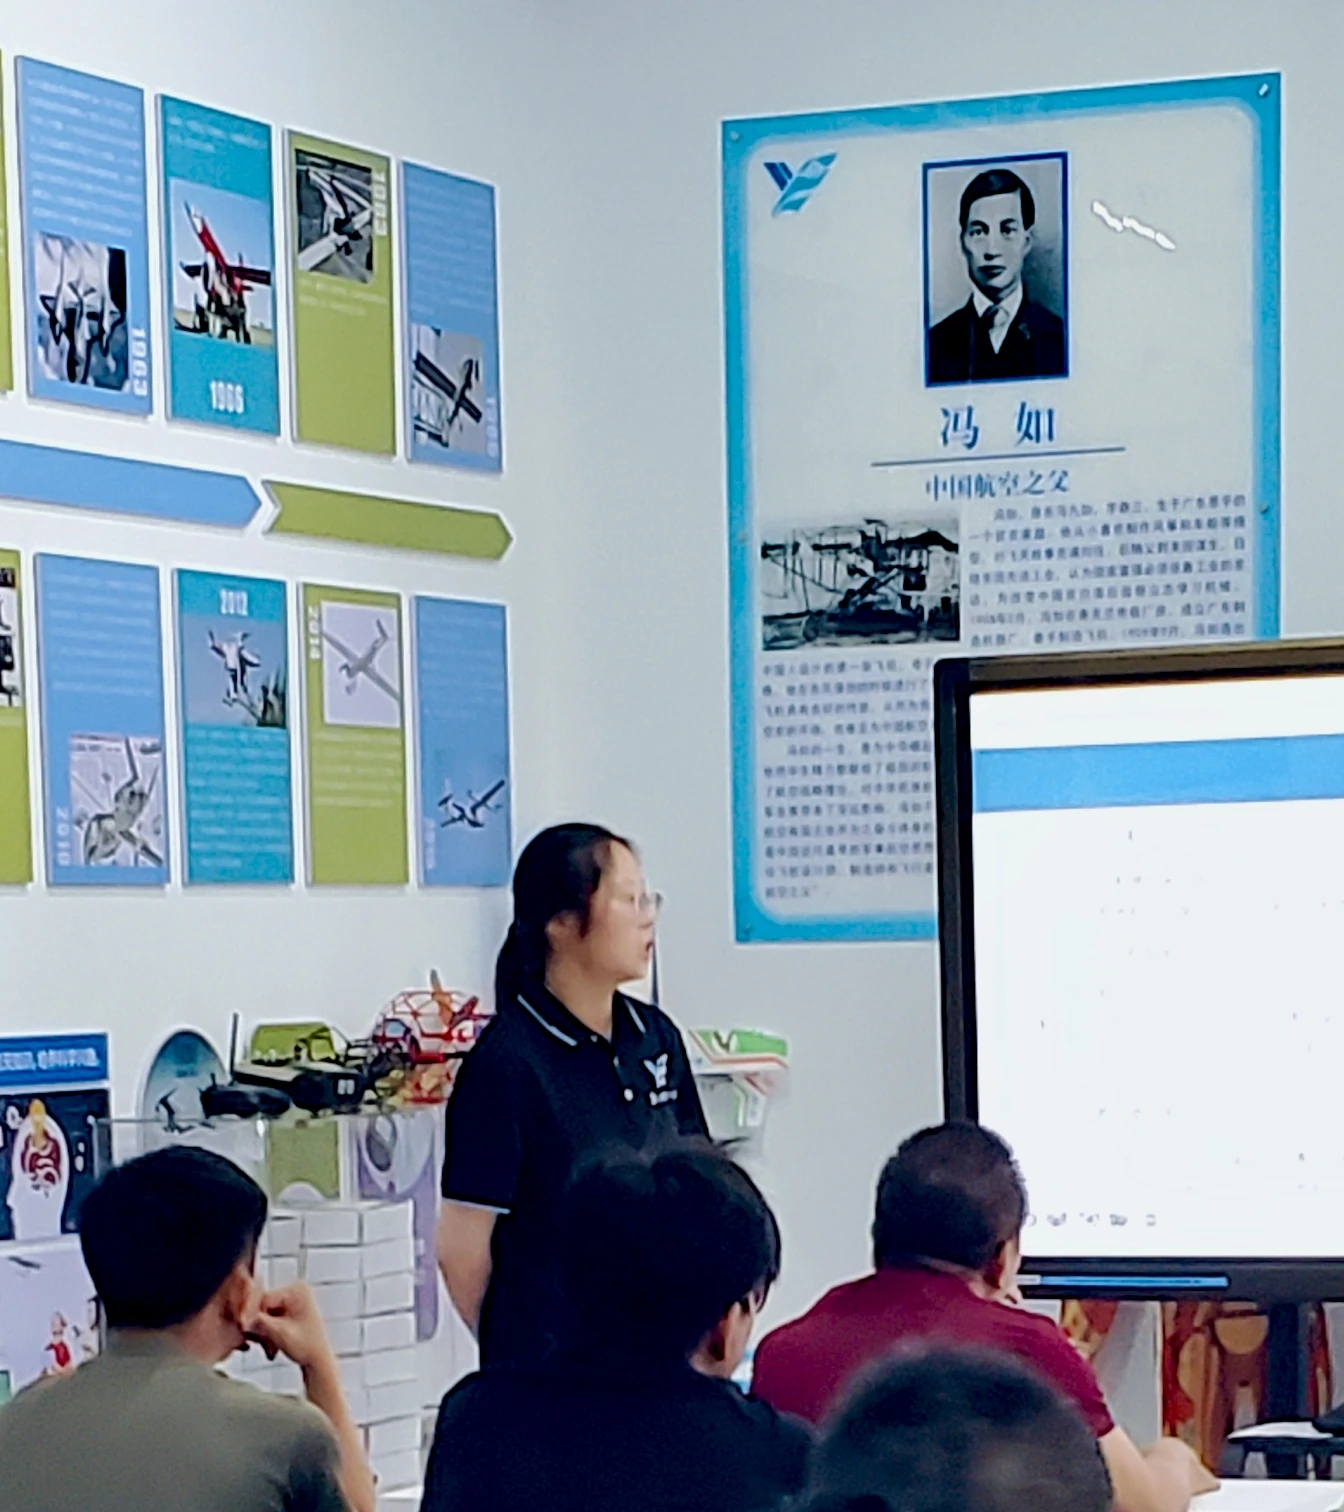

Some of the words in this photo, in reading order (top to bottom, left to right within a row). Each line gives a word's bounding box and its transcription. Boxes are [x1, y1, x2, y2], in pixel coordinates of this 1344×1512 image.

[940, 401, 1055, 450] 冯如
[926, 468, 1070, 502] 中国航空之父
